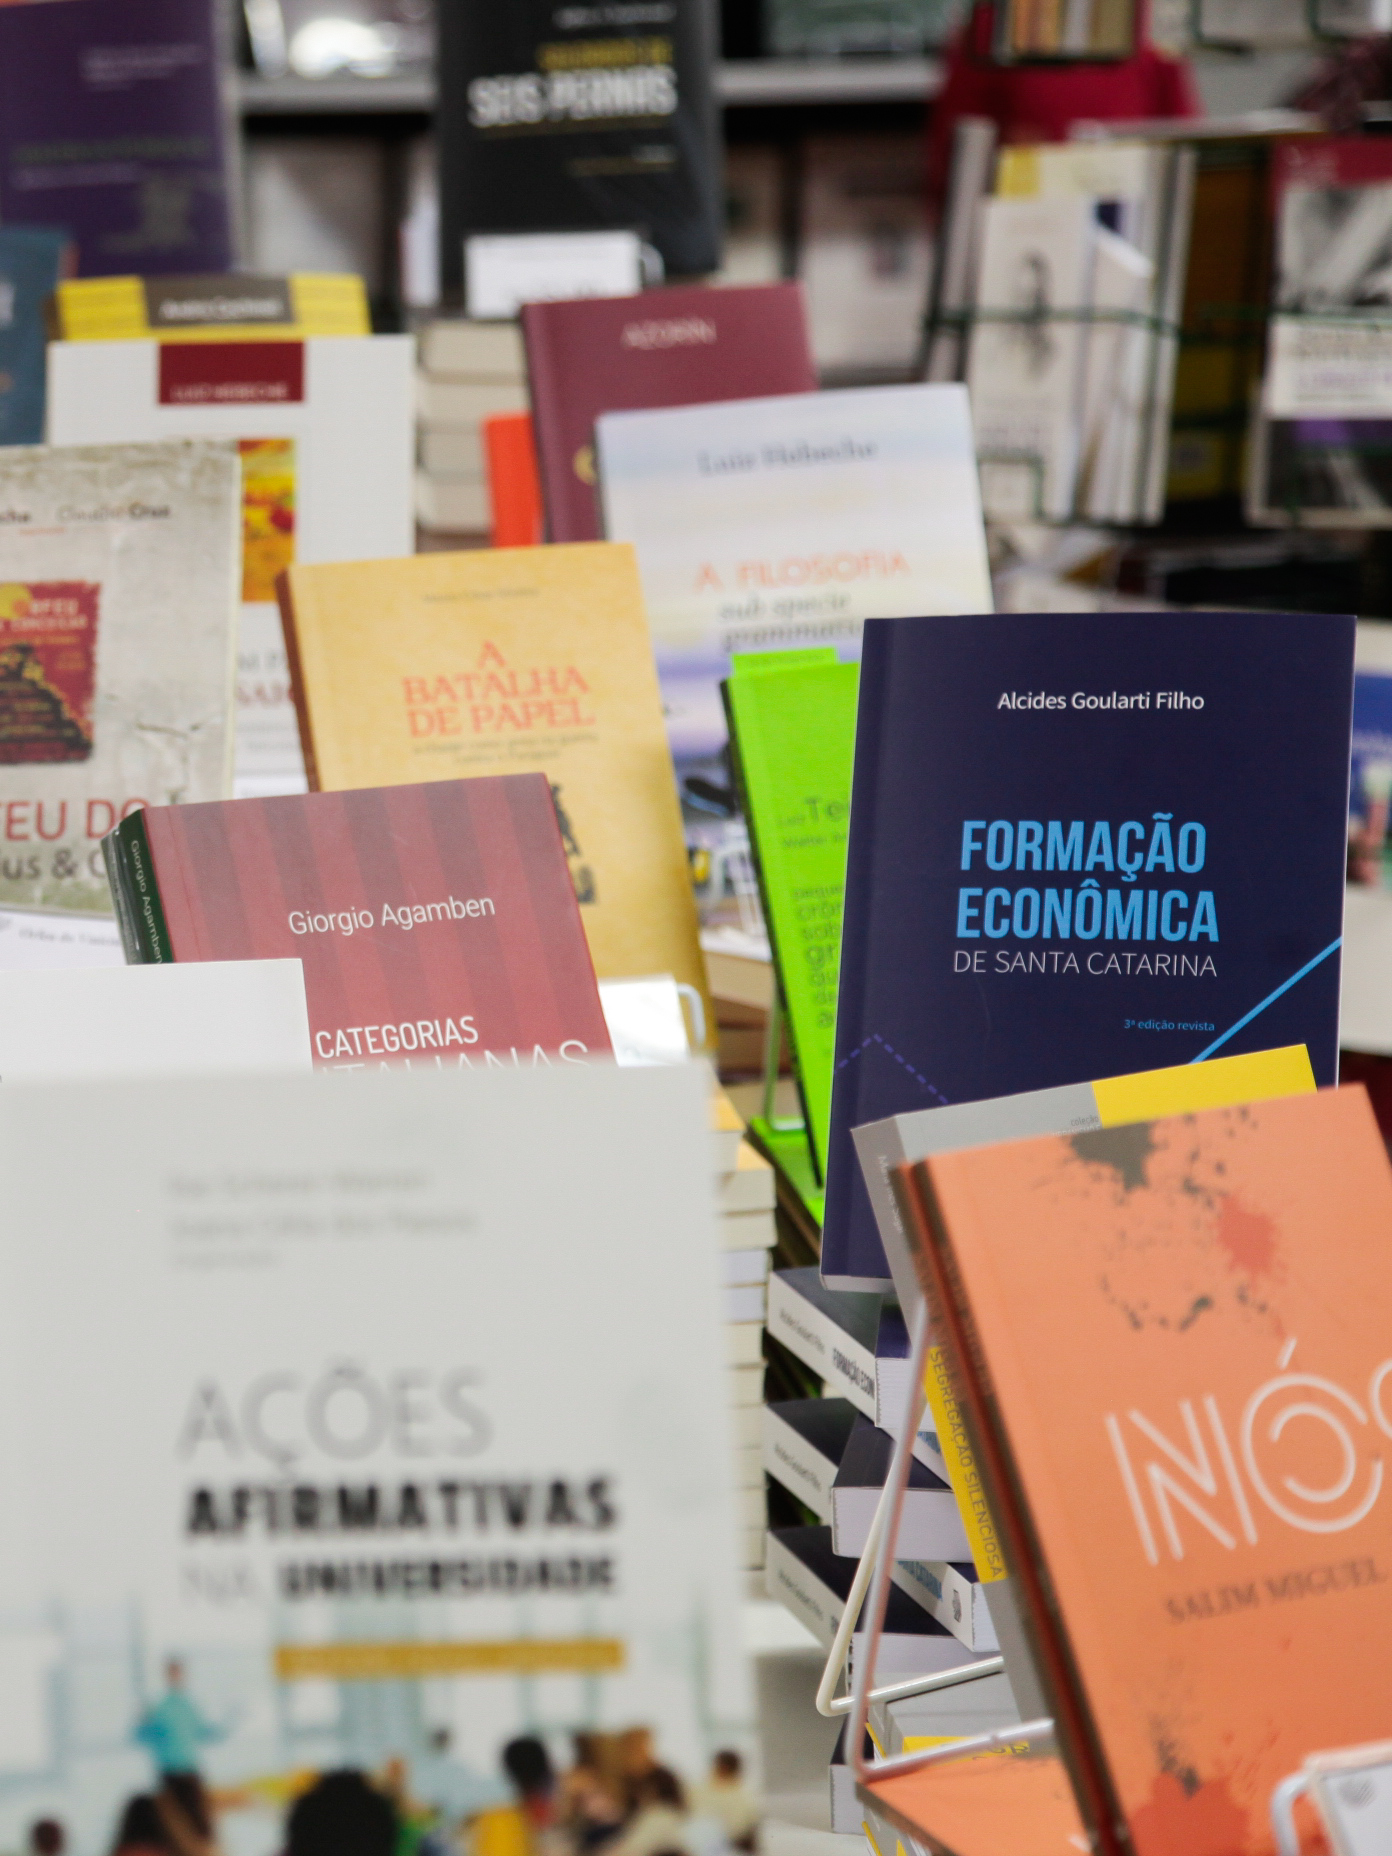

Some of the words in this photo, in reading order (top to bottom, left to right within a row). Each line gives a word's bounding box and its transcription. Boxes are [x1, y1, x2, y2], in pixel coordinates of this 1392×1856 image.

[468, 73, 544, 128] SEIS
[737, 550, 912, 588] FILOSOFIA
[477, 640, 506, 669] A
[401, 665, 591, 706] BATALHA
[997, 691, 1067, 710] Alcides
[1071, 691, 1150, 710] Goularti
[1156, 691, 1204, 710] Filho
[408, 705, 464, 739] DE
[470, 699, 597, 735] PAPEL
[51, 848, 78, 879] &
[130, 839, 147, 893] Giorgio
[960, 812, 1207, 882] FORMAÇÃO
[288, 906, 375, 937] Giorgio
[381, 894, 496, 931] Agamben
[956, 878, 1219, 942] ECONÔMICA
[953, 951, 987, 973] DE
[994, 951, 1080, 974] SANTA
[1087, 952, 1218, 978] CATARINA
[315, 1015, 479, 1060] CATEGORIAS
[1138, 1019, 1175, 1032] edição
[1177, 1020, 1215, 1032] revista
[1070, 1114, 1100, 1128] coleção
[175, 1355, 494, 1478] AÇÕES
[929, 1350, 975, 1469] SEGREGAÇÃO
[964, 1473, 1007, 1578] SILENCIOSA
[1105, 1335, 1392, 1567] NÓ
[186, 1476, 618, 1537] AFIRMATIVAS
[281, 1557, 615, 1597] UNIVERSIDADE
[1166, 1581, 1259, 1624] SALIM
[1264, 1555, 1388, 1601] MIGUEL
